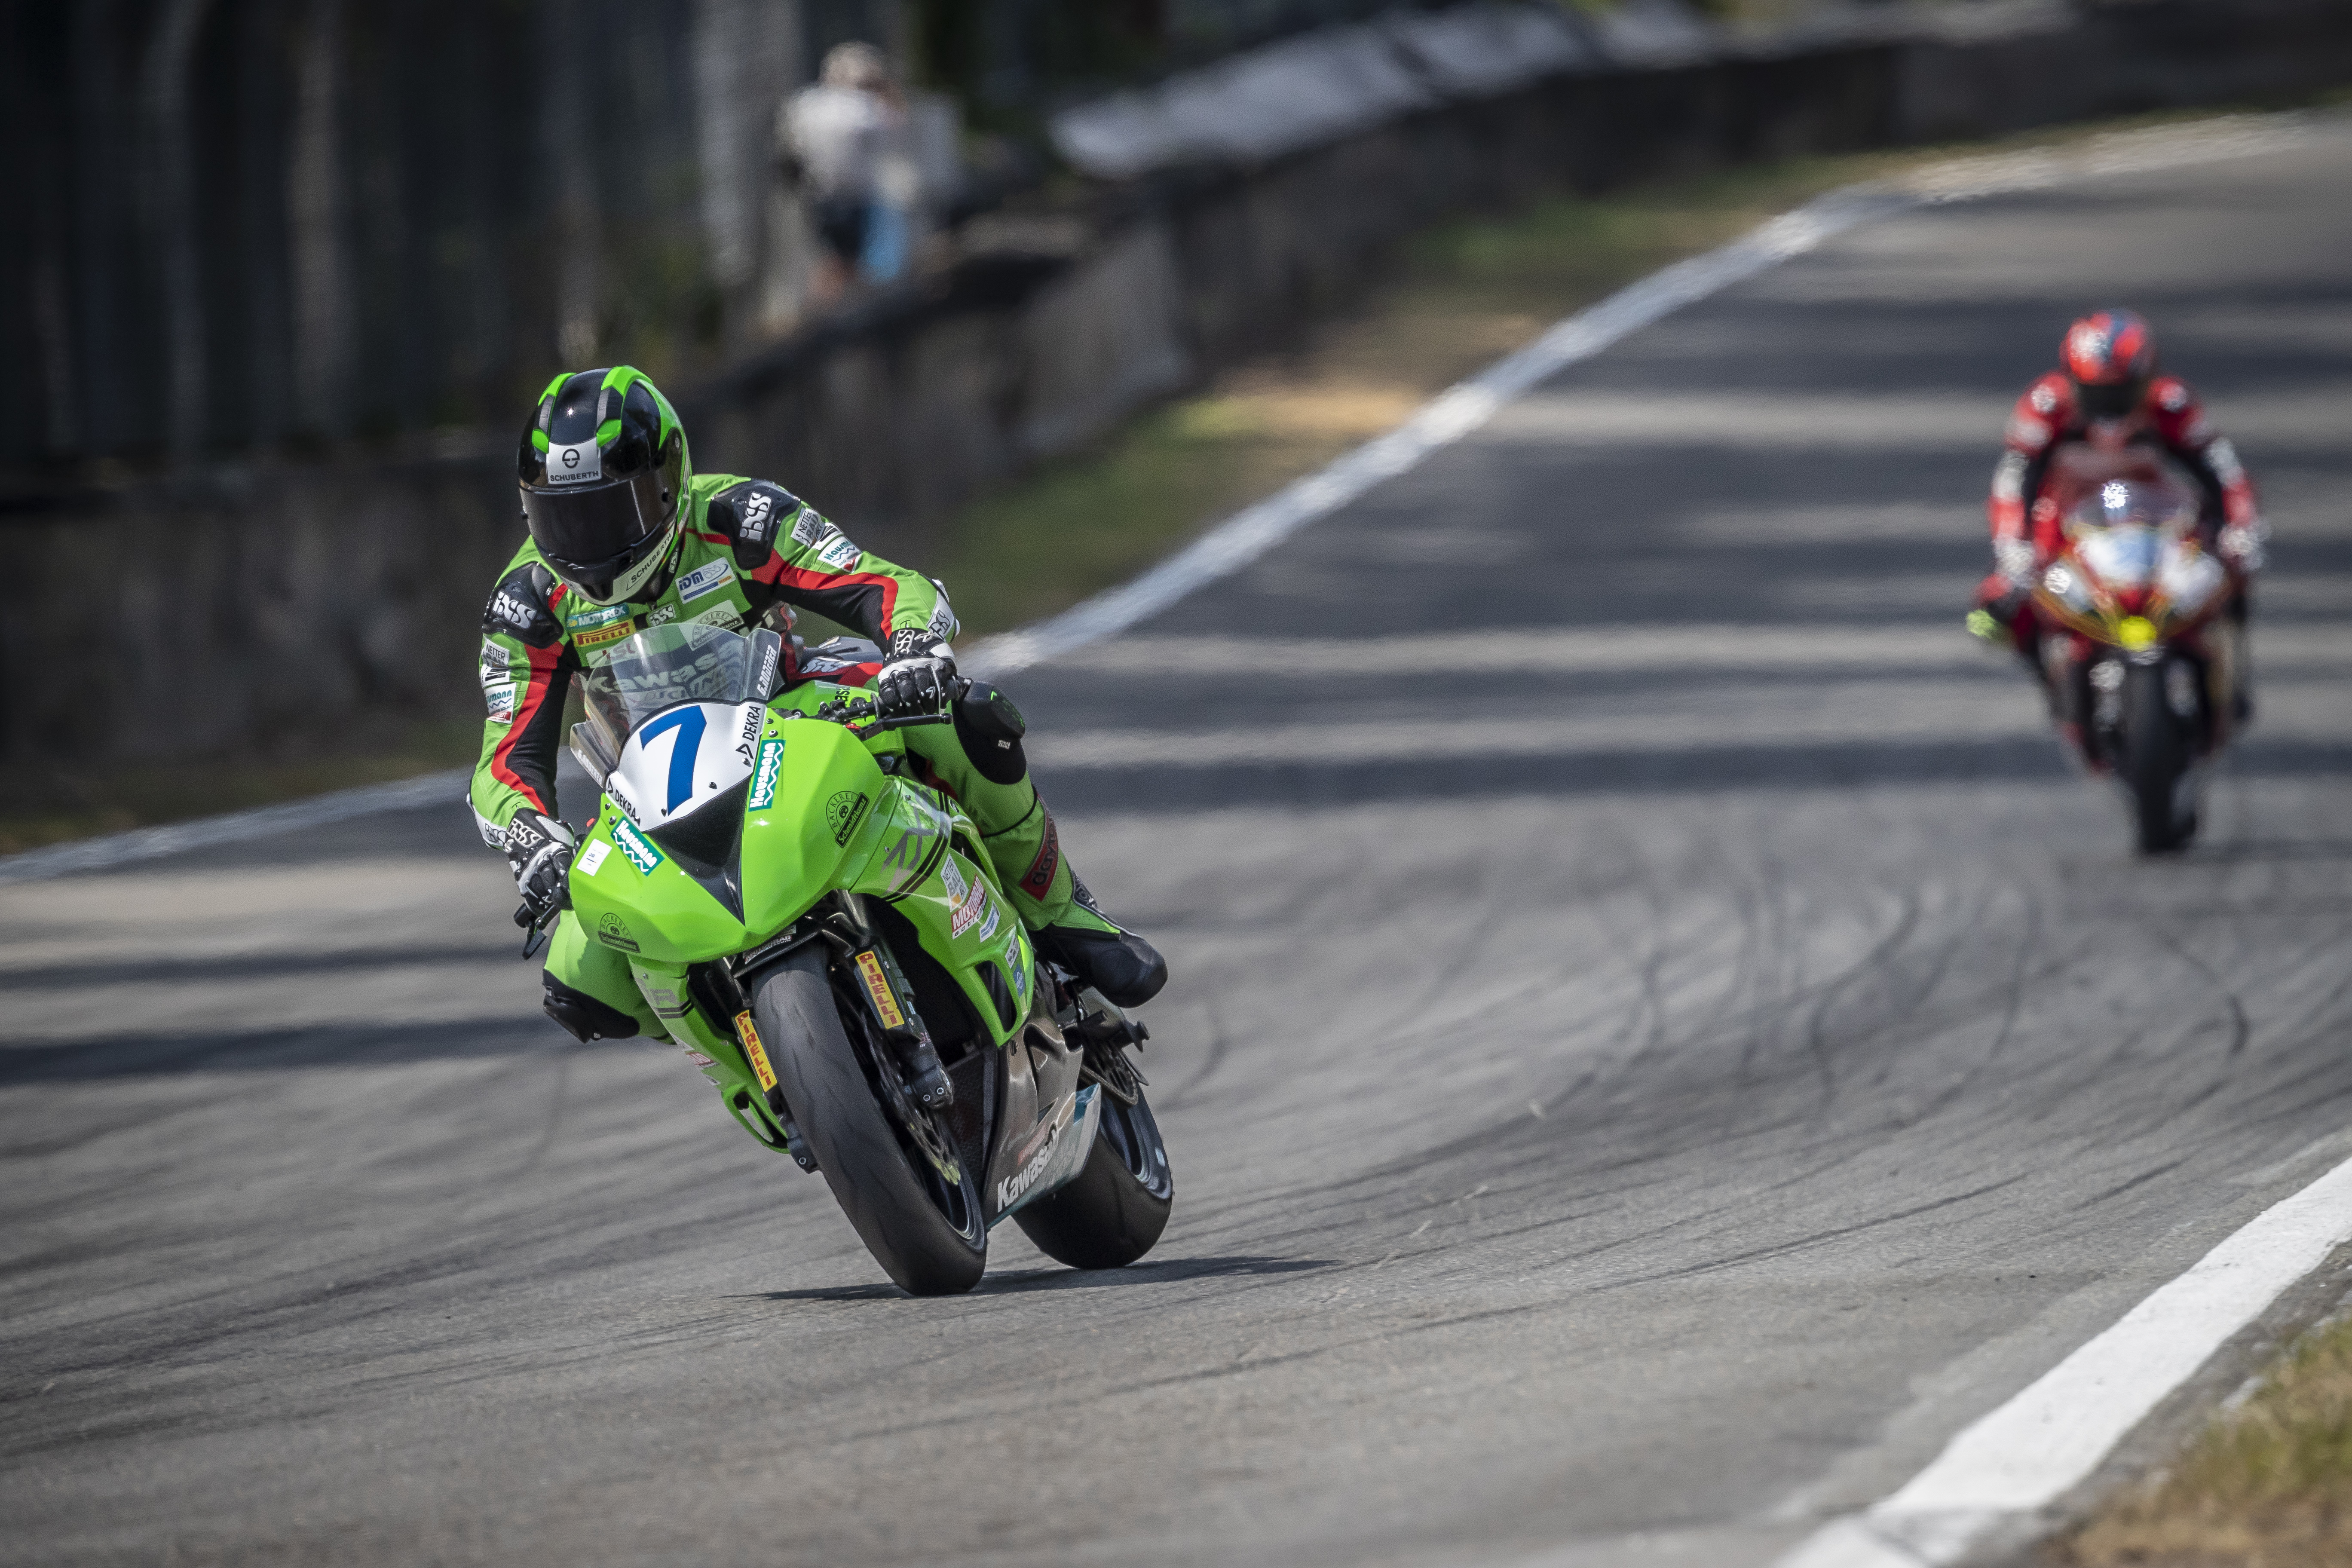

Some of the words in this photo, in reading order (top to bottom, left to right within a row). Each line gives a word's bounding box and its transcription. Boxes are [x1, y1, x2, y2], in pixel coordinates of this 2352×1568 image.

[550, 471, 599, 482] SCHUBERTH
[798, 510, 812, 534] NETTER
[631, 533, 671, 583] SCHUBERTH
[486, 643, 505, 661] NETTER
[576, 622, 630, 645] PIRELLI
[742, 706, 761, 742] DEKRA
[639, 705, 707, 816] 7
[750, 742, 776, 808] Hausmann
[615, 789, 636, 818] DEKRA
[616, 820, 657, 868] Hausmann
[860, 953, 897, 1025] PIRELLI
[737, 1013, 772, 1087] PIRELLI
